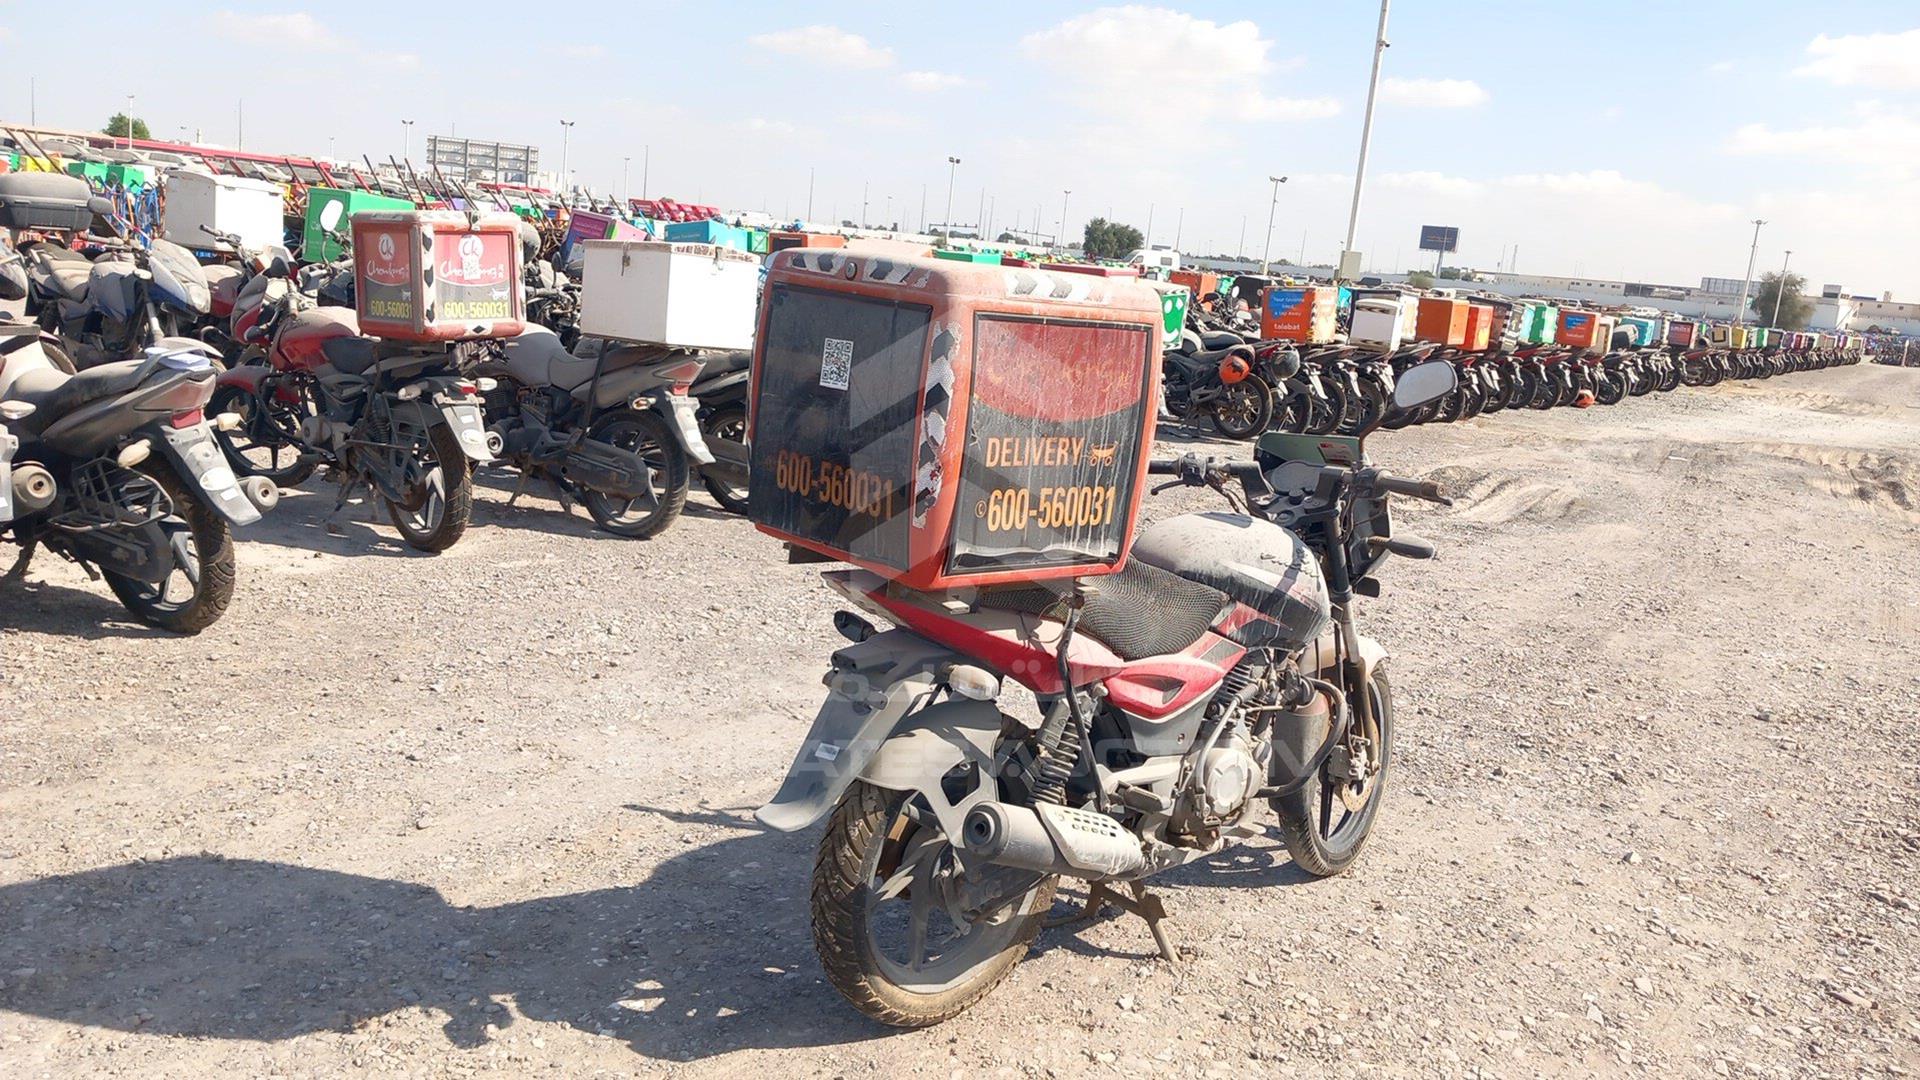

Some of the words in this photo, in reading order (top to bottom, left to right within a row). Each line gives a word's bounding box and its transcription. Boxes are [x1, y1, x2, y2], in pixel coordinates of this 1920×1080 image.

[370, 300, 412, 319] 600-560031
[444, 301, 509, 318] 600-560031
[985, 437, 1085, 468] DELIVERY
[776, 449, 894, 520] 600-560031
[987, 486, 1116, 531] 600-560031
